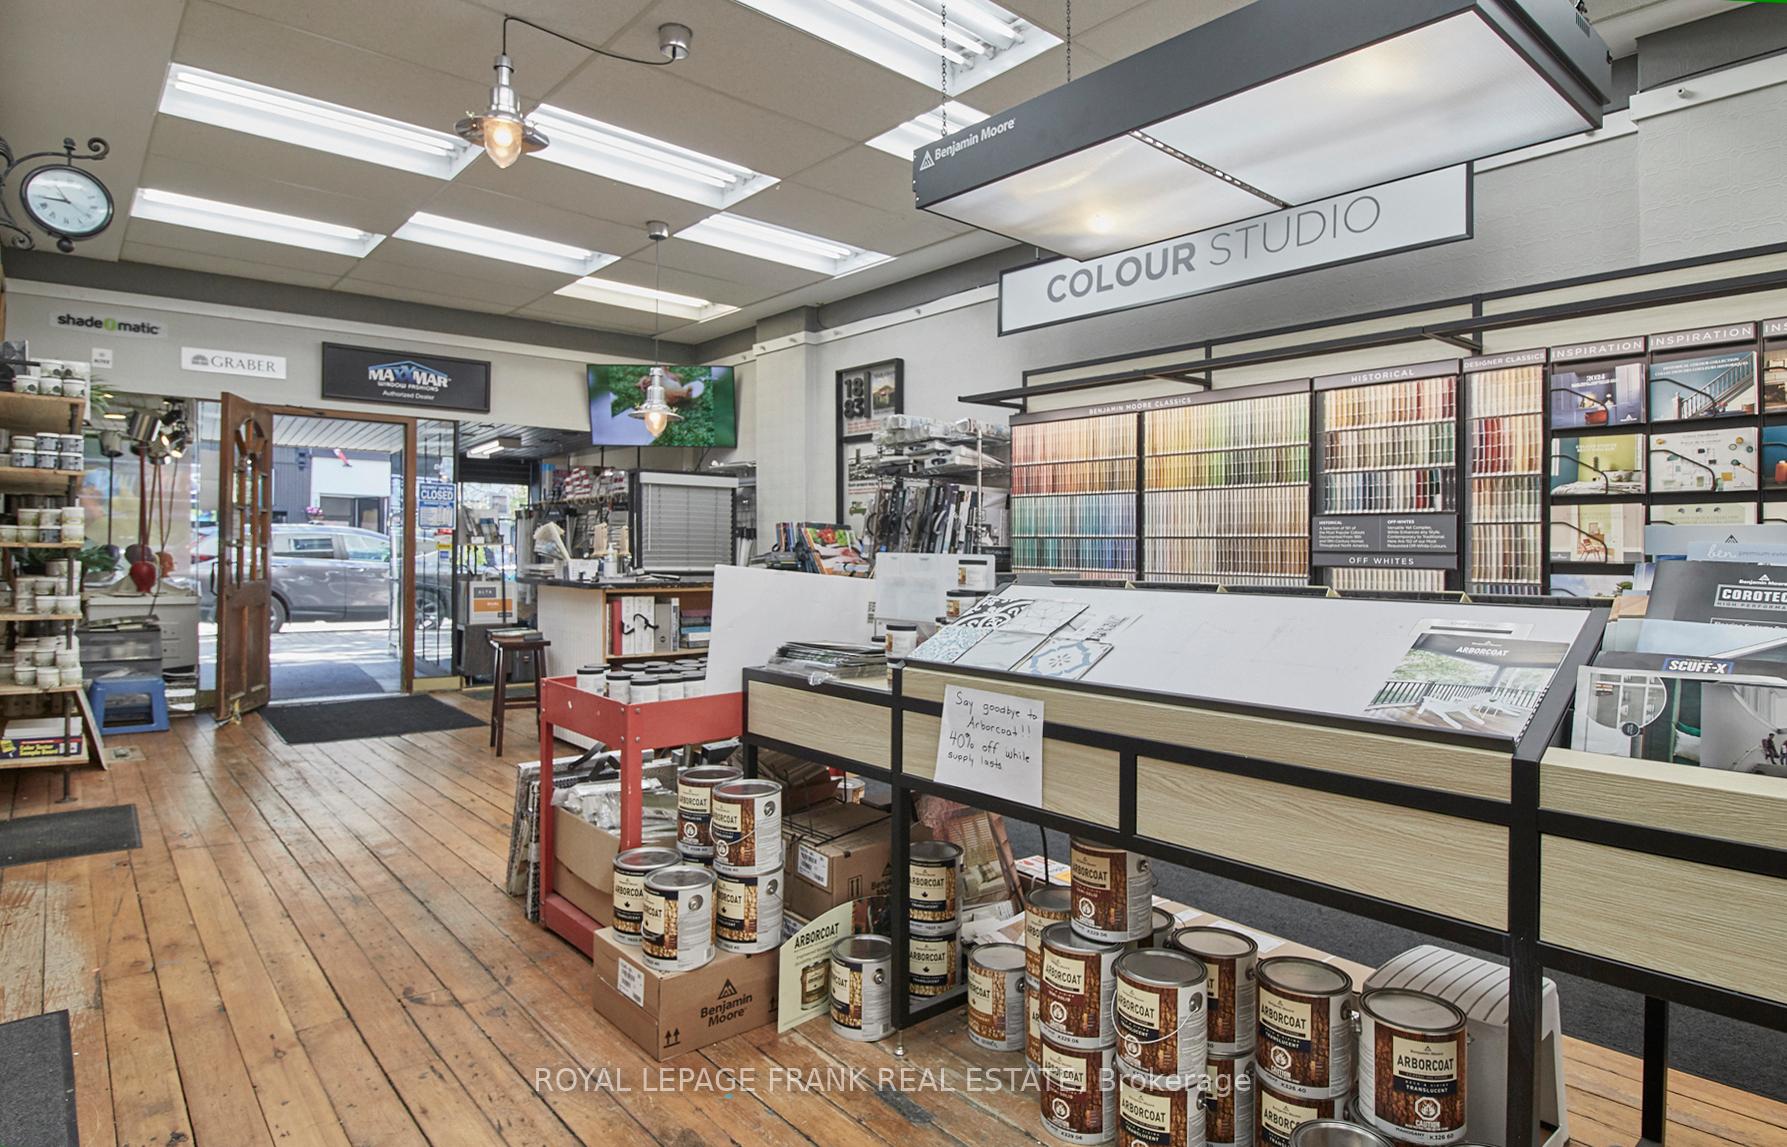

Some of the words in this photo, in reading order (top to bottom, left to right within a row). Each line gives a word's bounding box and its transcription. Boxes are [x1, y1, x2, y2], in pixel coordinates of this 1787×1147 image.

[934, 132, 979, 161] Benjamin
[980, 119, 1015, 141] Moore
[1047, 242, 1196, 303] COLOUR
[1209, 196, 1381, 266] STUDIO
[1651, 327, 1751, 346] INSPIRATION
[1552, 341, 1642, 359] INSPIRATION
[210, 356, 276, 373] GRABER
[1464, 357, 1503, 369] DESIGNER
[1505, 353, 1545, 364] CLASSICS
[368, 365, 448, 388] MAXXMAR
[1351, 369, 1415, 383] HISTORICAL
[382, 390, 414, 399] Authorized
[416, 392, 435, 400] Dealer
[1089, 405, 1123, 415] BENJAMIN
[1126, 402, 1152, 410] MOORE
[1155, 397, 1191, 407] CLASSICS
[421, 489, 453, 500] CLOSED
[1348, 556, 1368, 564] OFF
[1373, 557, 1414, 566] WHITES
[1456, 646, 1509, 657] ARBORCOAT
[1669, 660, 1727, 674] SCUFF-X
[955, 691, 974, 715] Say
[983, 703, 1020, 720] goodbye
[1027, 709, 1038, 720] to
[967, 716, 1031, 738] Arborcoat!!
[949, 730, 975, 749] 40%
[981, 740, 1000, 754] off
[1005, 748, 1030, 764] while
[947, 751, 974, 768] supply
[980, 757, 1002, 770] lasts
[794, 922, 840, 950] ARBORCOAT
[700, 994, 753, 1018] Benjamin
[708, 1009, 744, 1027] Moore
[1261, 1004, 1307, 1030] ARBORCOAT
[1397, 1055, 1454, 1072] ARBORCOAT
[1406, 1084, 1448, 1094] TRANSLUCENT
[1121, 1100, 1166, 1123] ARBORCOAT
